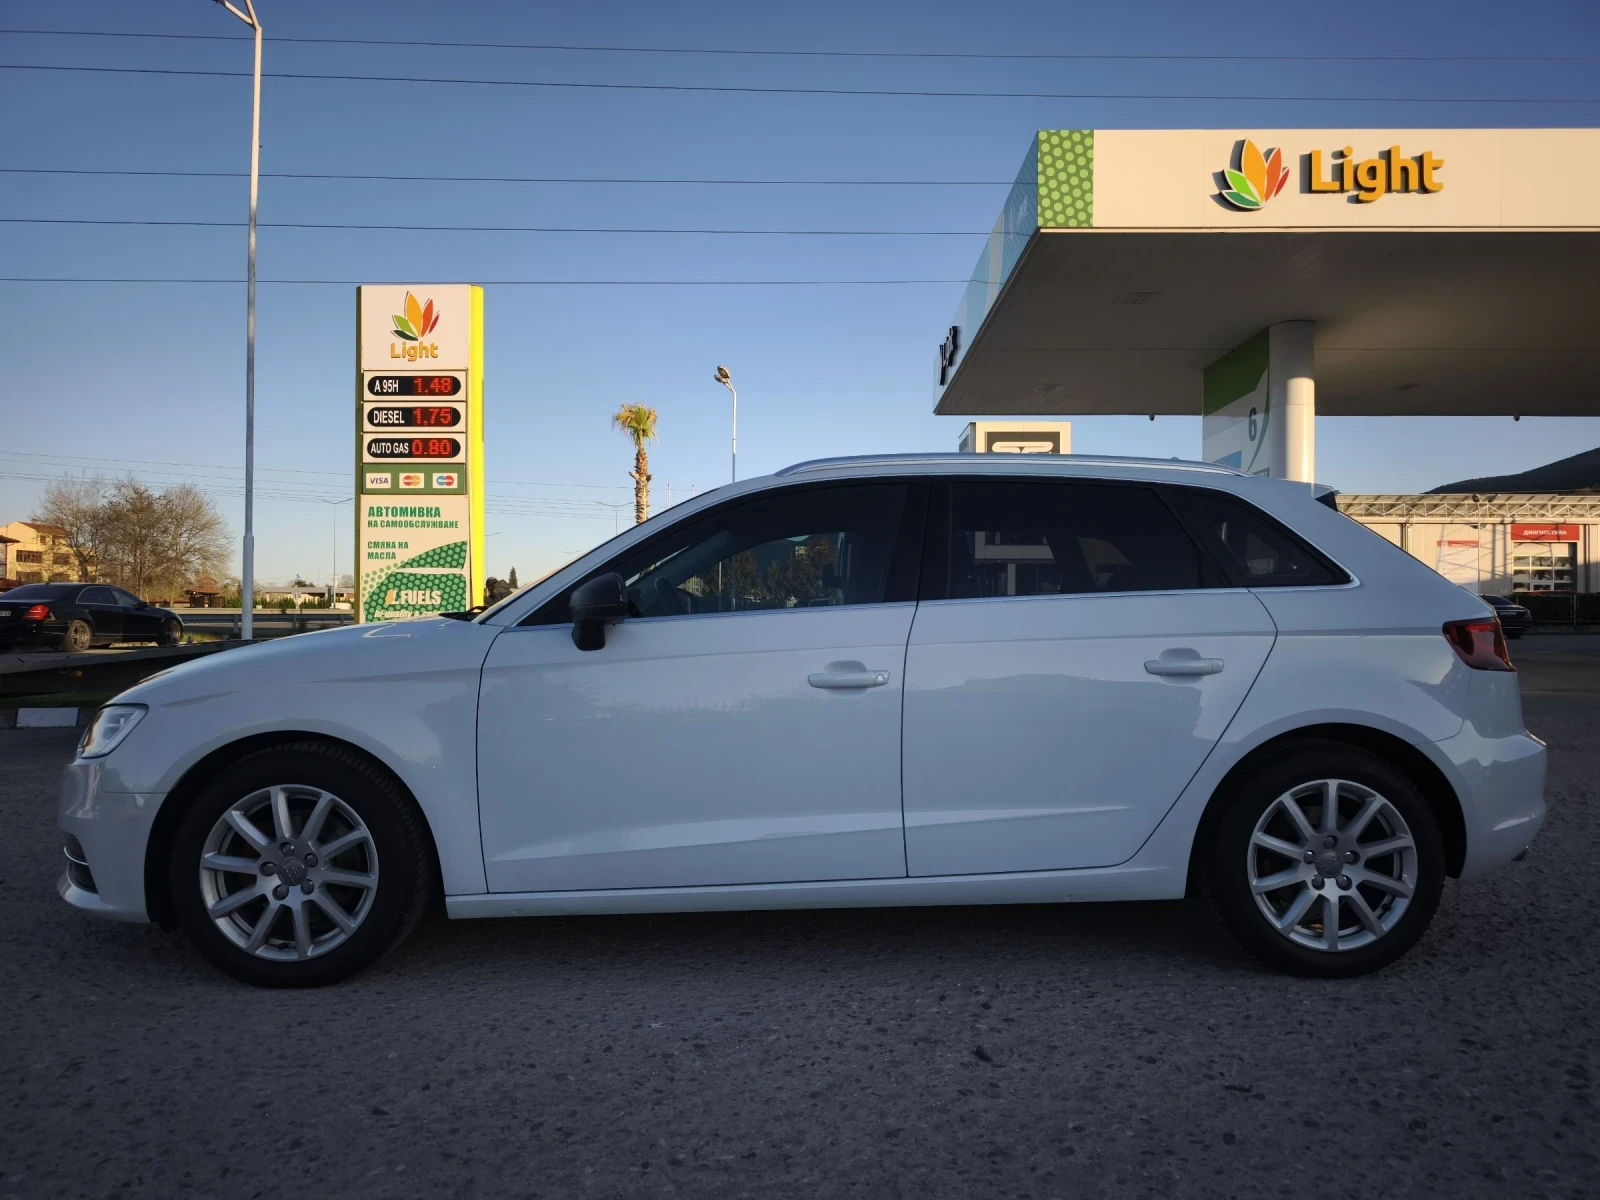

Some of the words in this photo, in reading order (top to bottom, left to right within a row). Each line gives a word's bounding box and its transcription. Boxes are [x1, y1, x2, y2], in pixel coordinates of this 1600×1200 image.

[1309, 145, 1445, 203] Light
[390, 341, 439, 362] Light
[374, 379, 381, 393] A
[383, 379, 399, 393] 95H
[413, 377, 452, 394] 1.48
[373, 410, 405, 424] DIESEL
[413, 408, 452, 425] 1.75
[1248, 407, 1258, 441] 6
[370, 442, 392, 454] AUTO
[393, 442, 409, 454] GAS
[411, 439, 451, 455] 0.80
[368, 506, 441, 518] АВТОМИВКА
[367, 520, 379, 528] НА
[380, 520, 459, 529] САМООБСЛУЖВАНЕ
[367, 541, 396, 549] СМЯНА
[398, 541, 409, 549] НА
[367, 552, 396, 560] МАСЛА
